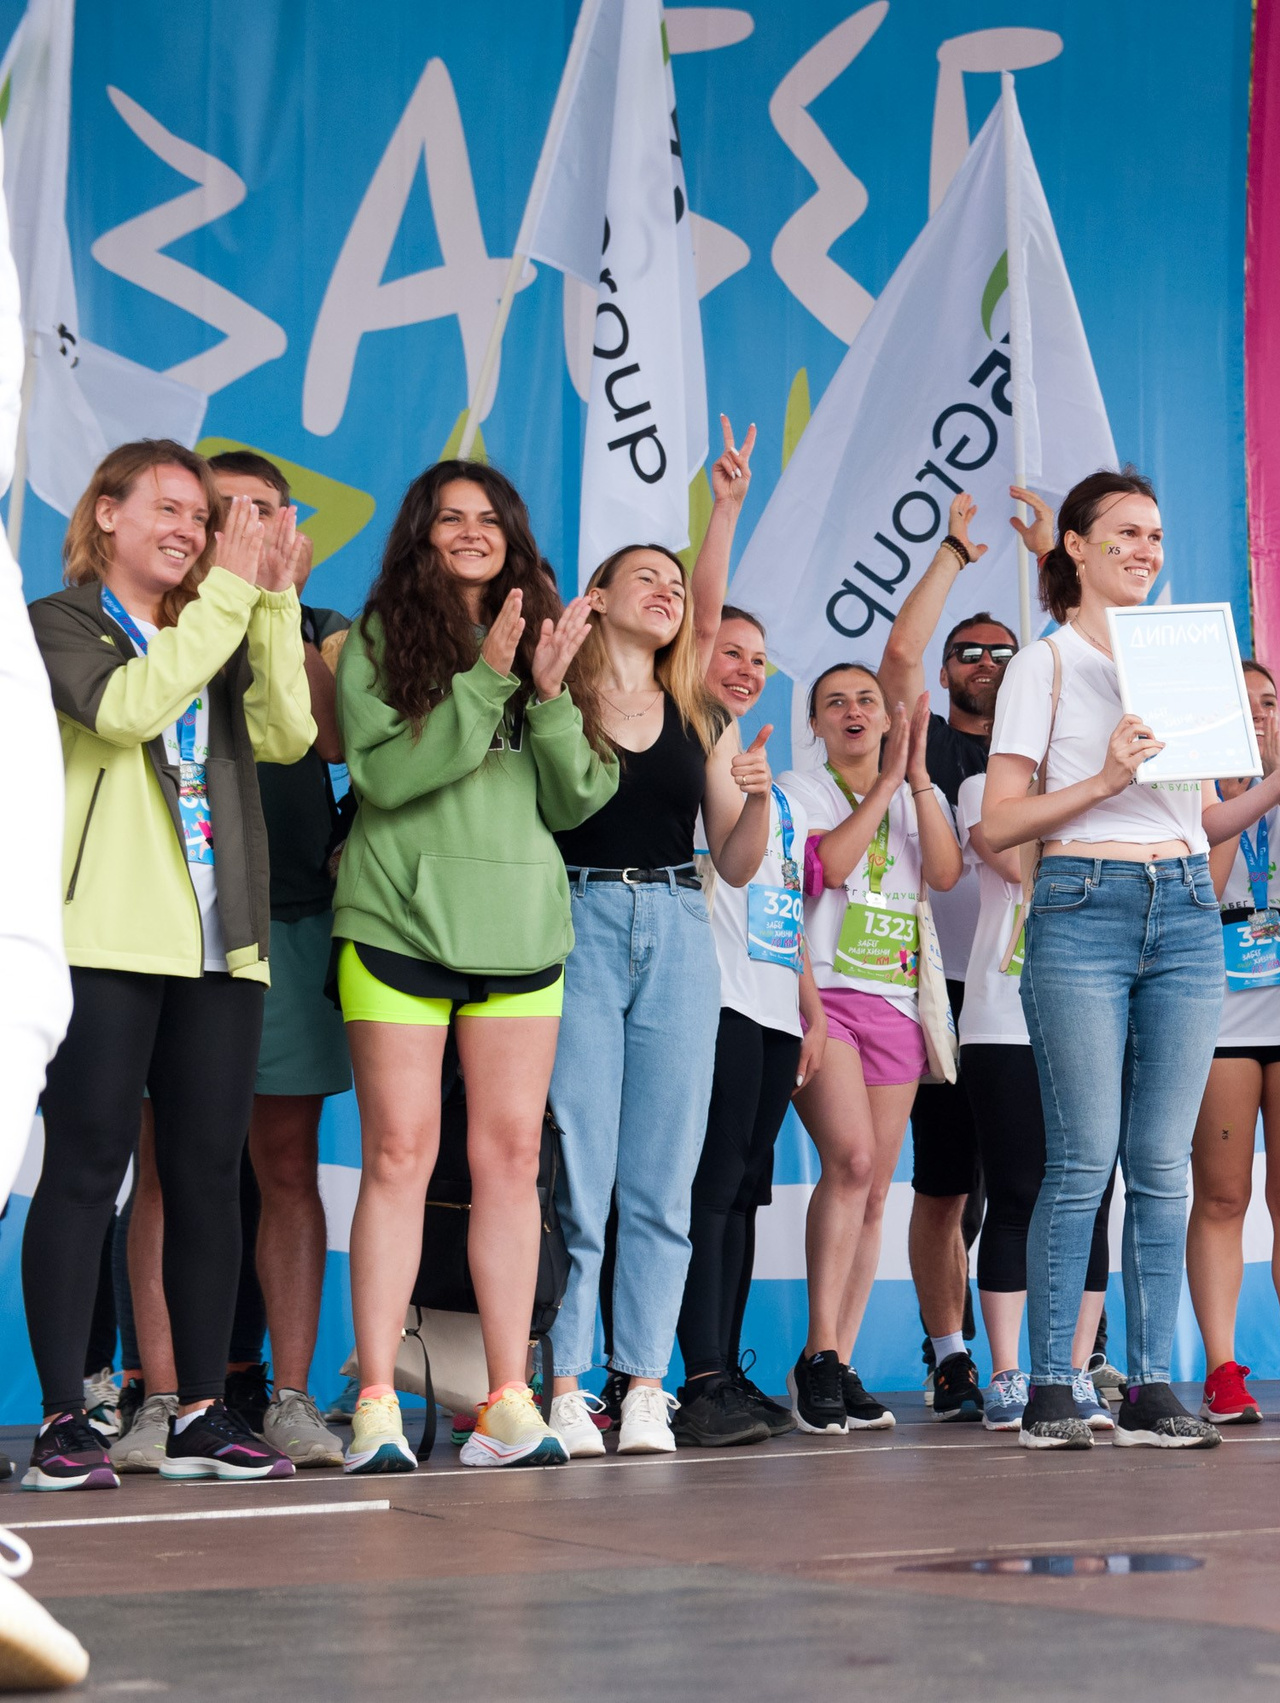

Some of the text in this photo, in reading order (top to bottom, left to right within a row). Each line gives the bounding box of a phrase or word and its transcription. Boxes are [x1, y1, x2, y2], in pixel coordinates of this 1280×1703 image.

[593, 216, 668, 485] roup
[1108, 546, 1120, 555] X5
[1130, 623, 1220, 648] ДИПЛОМ
[763, 891, 803, 924] 320
[1221, 901, 1249, 910] АБЕГ
[766, 921, 784, 929] ЗАБЕГ
[864, 911, 914, 942] 1323
[858, 939, 879, 947] ЗАБЕГ
[1242, 949, 1261, 961] ЗАБЕГ
